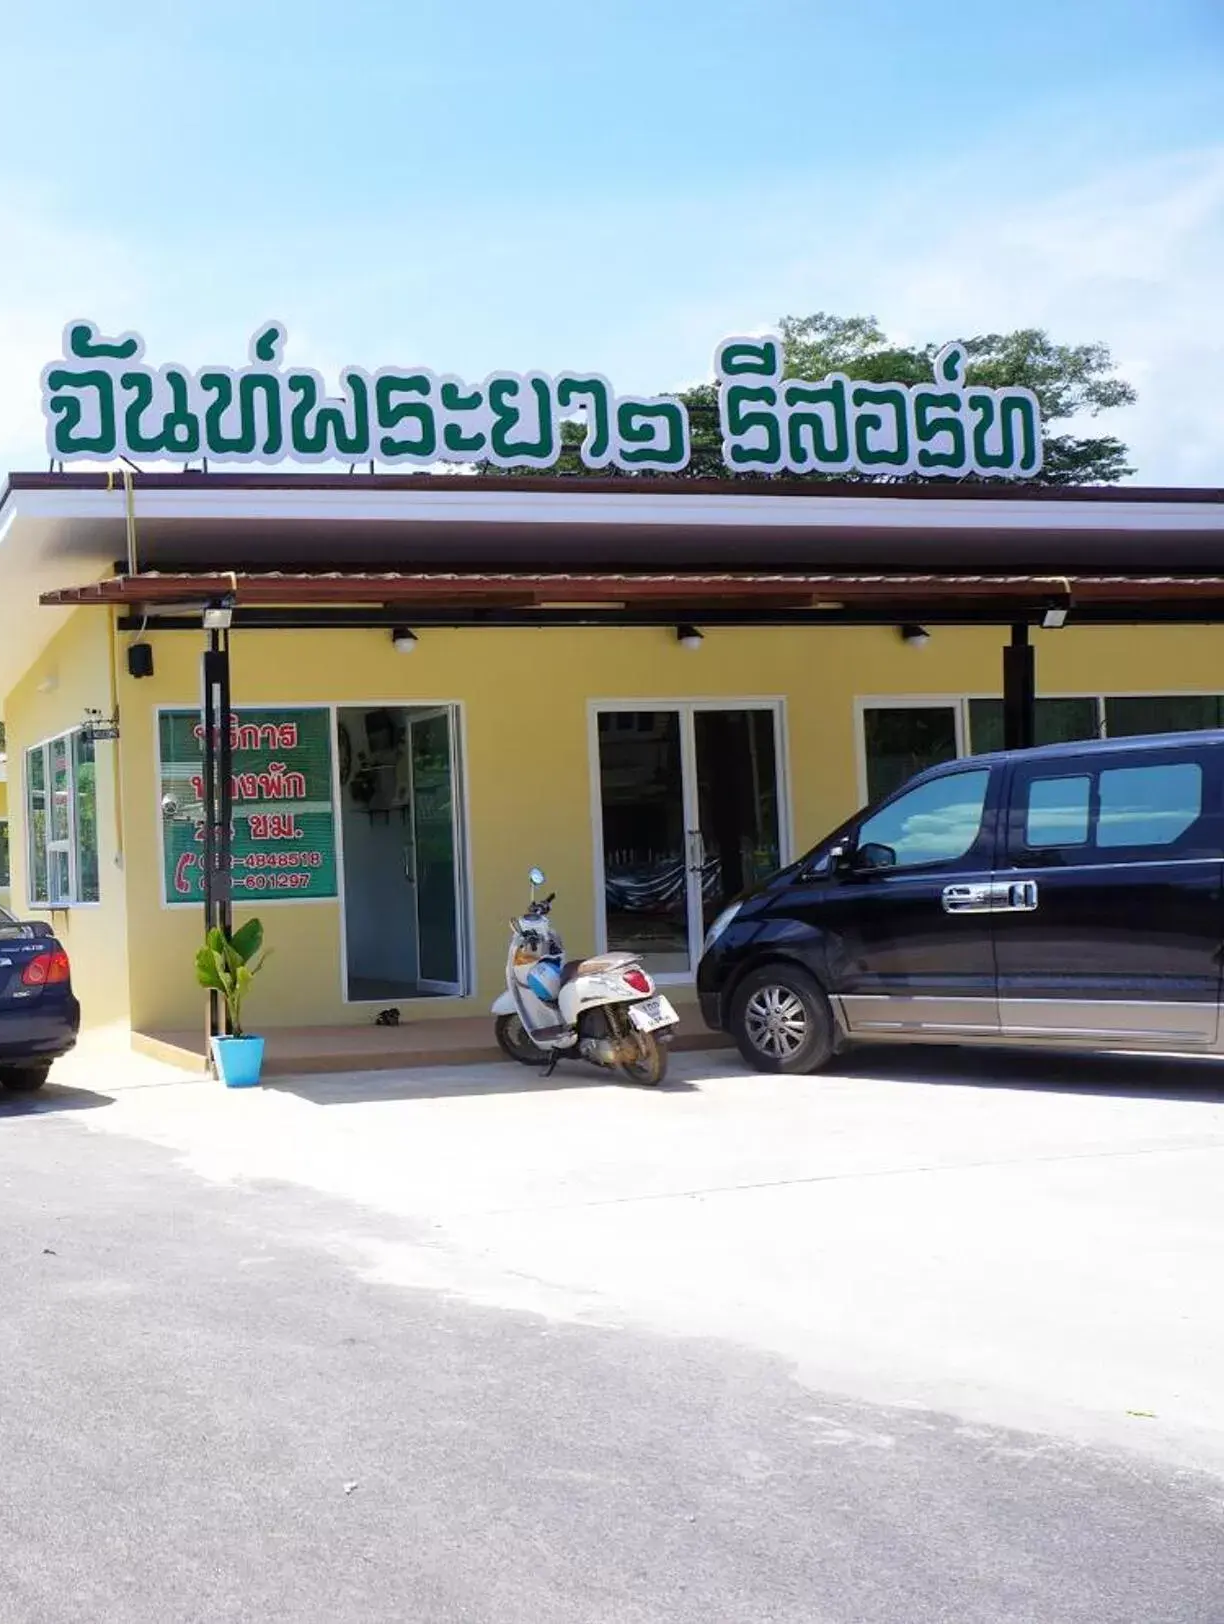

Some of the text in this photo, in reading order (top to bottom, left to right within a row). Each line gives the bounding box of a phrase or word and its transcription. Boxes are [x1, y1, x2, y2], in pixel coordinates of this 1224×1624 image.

[720, 341, 1037, 470] รีสอร์ท
[198, 852, 322, 870] -4848518
[198, 873, 311, 890] -601297
